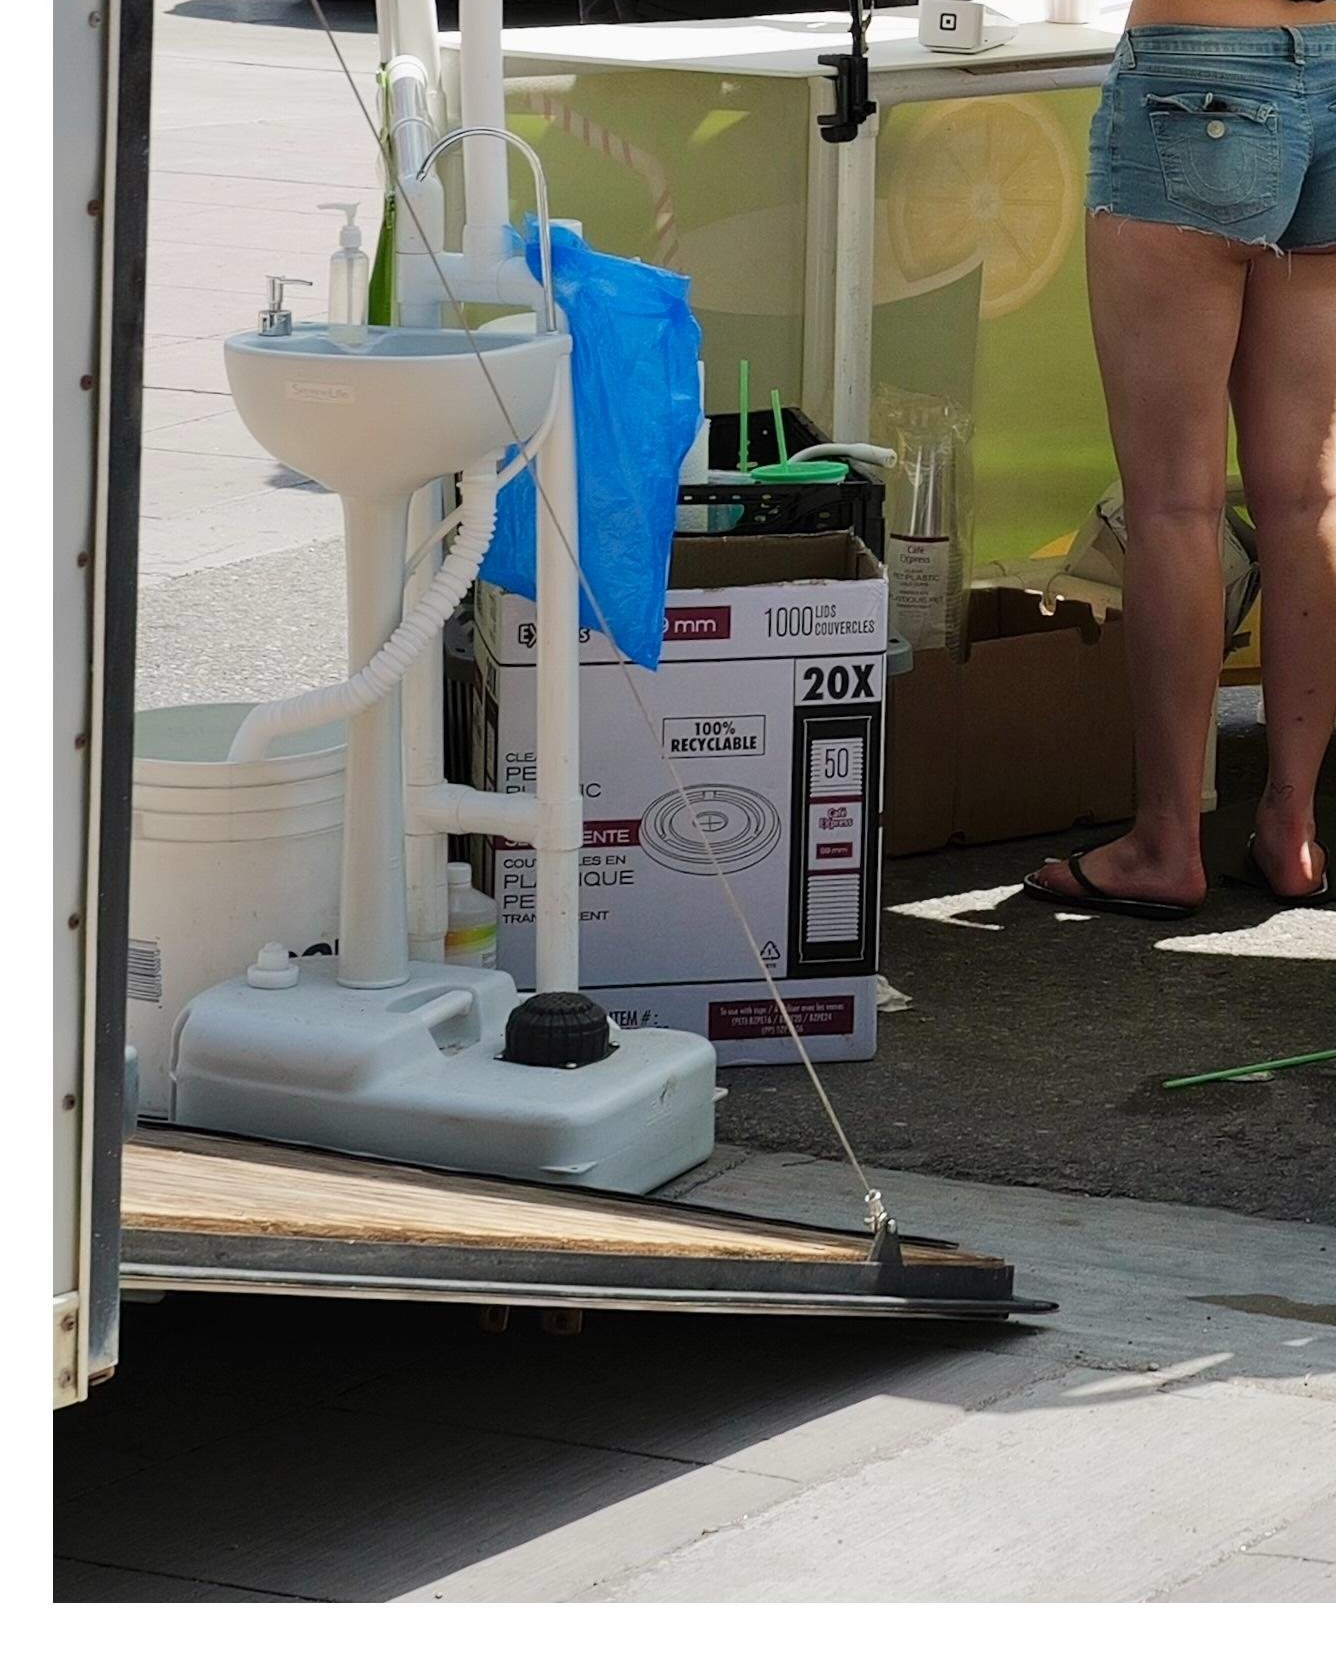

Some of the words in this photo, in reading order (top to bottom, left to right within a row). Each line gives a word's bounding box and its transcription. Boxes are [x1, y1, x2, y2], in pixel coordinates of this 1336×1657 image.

[674, 618, 717, 634] mm
[764, 606, 814, 640] 1000
[815, 604, 837, 619] LIDS
[814, 619, 876, 637] COUVERCLES
[802, 663, 876, 702] 20X
[693, 721, 736, 736] 100%
[670, 735, 758, 753] RECYCLABLE
[505, 752, 537, 763] CLE
[824, 747, 850, 779] 50
[505, 766, 537, 782] PE
[582, 829, 630, 844] ENTE
[605, 854, 626, 866] EN
[503, 870, 635, 890] PLIQUE
[502, 894, 536, 910] PE
